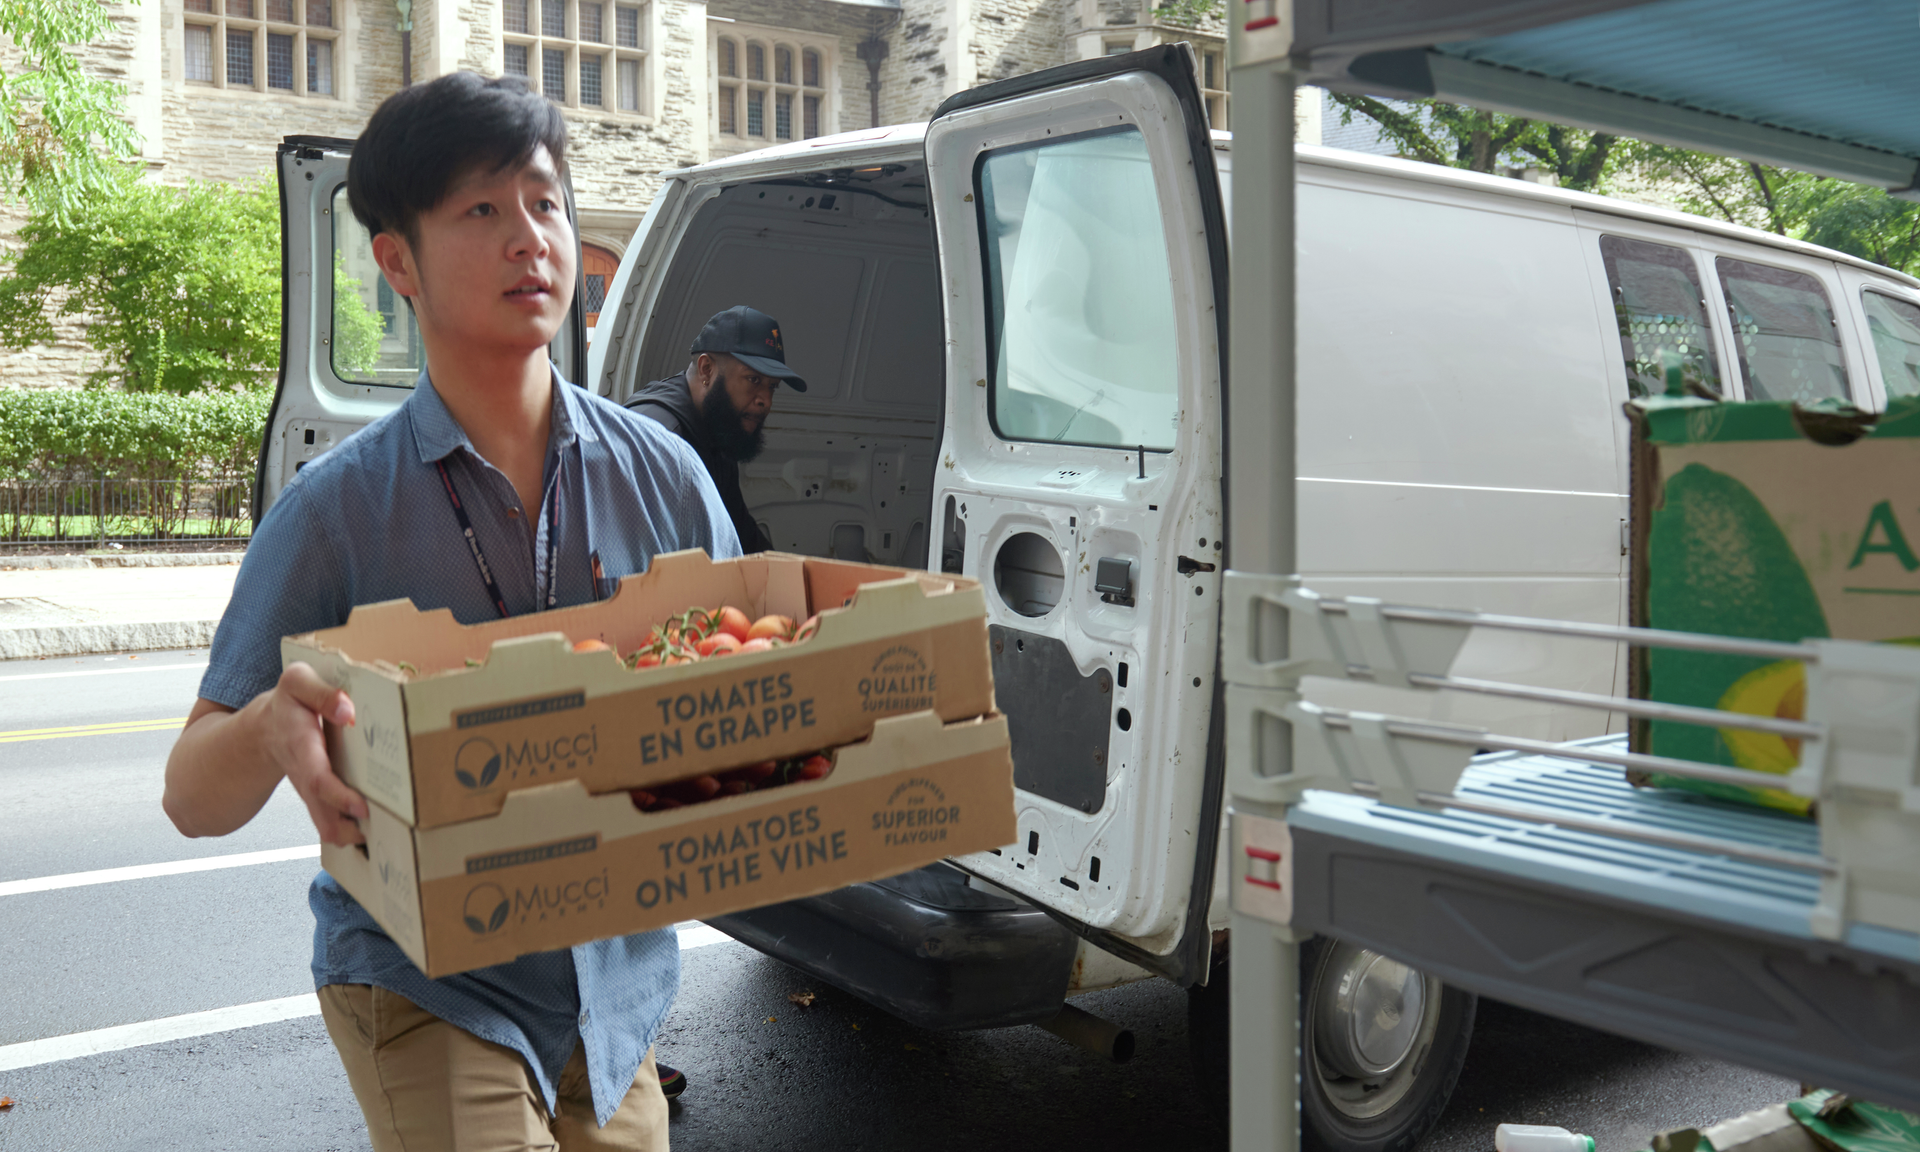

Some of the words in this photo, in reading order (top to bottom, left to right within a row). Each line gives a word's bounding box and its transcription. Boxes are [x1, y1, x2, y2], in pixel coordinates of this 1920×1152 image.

[1847, 499, 1920, 573] A
[657, 672, 794, 726] TOMATES
[858, 669, 937, 698] QUALITÉ
[505, 724, 598, 770] Mucci
[639, 728, 683, 766] EN
[695, 697, 817, 751] GRAPPE
[658, 805, 821, 870] TOMATOES
[872, 805, 960, 831] SUPERIOR
[885, 828, 947, 847] FLAVOUR
[515, 867, 609, 914] Mucci
[636, 871, 688, 909] ON
[698, 853, 762, 894] THE
[770, 830, 848, 874] VINE
